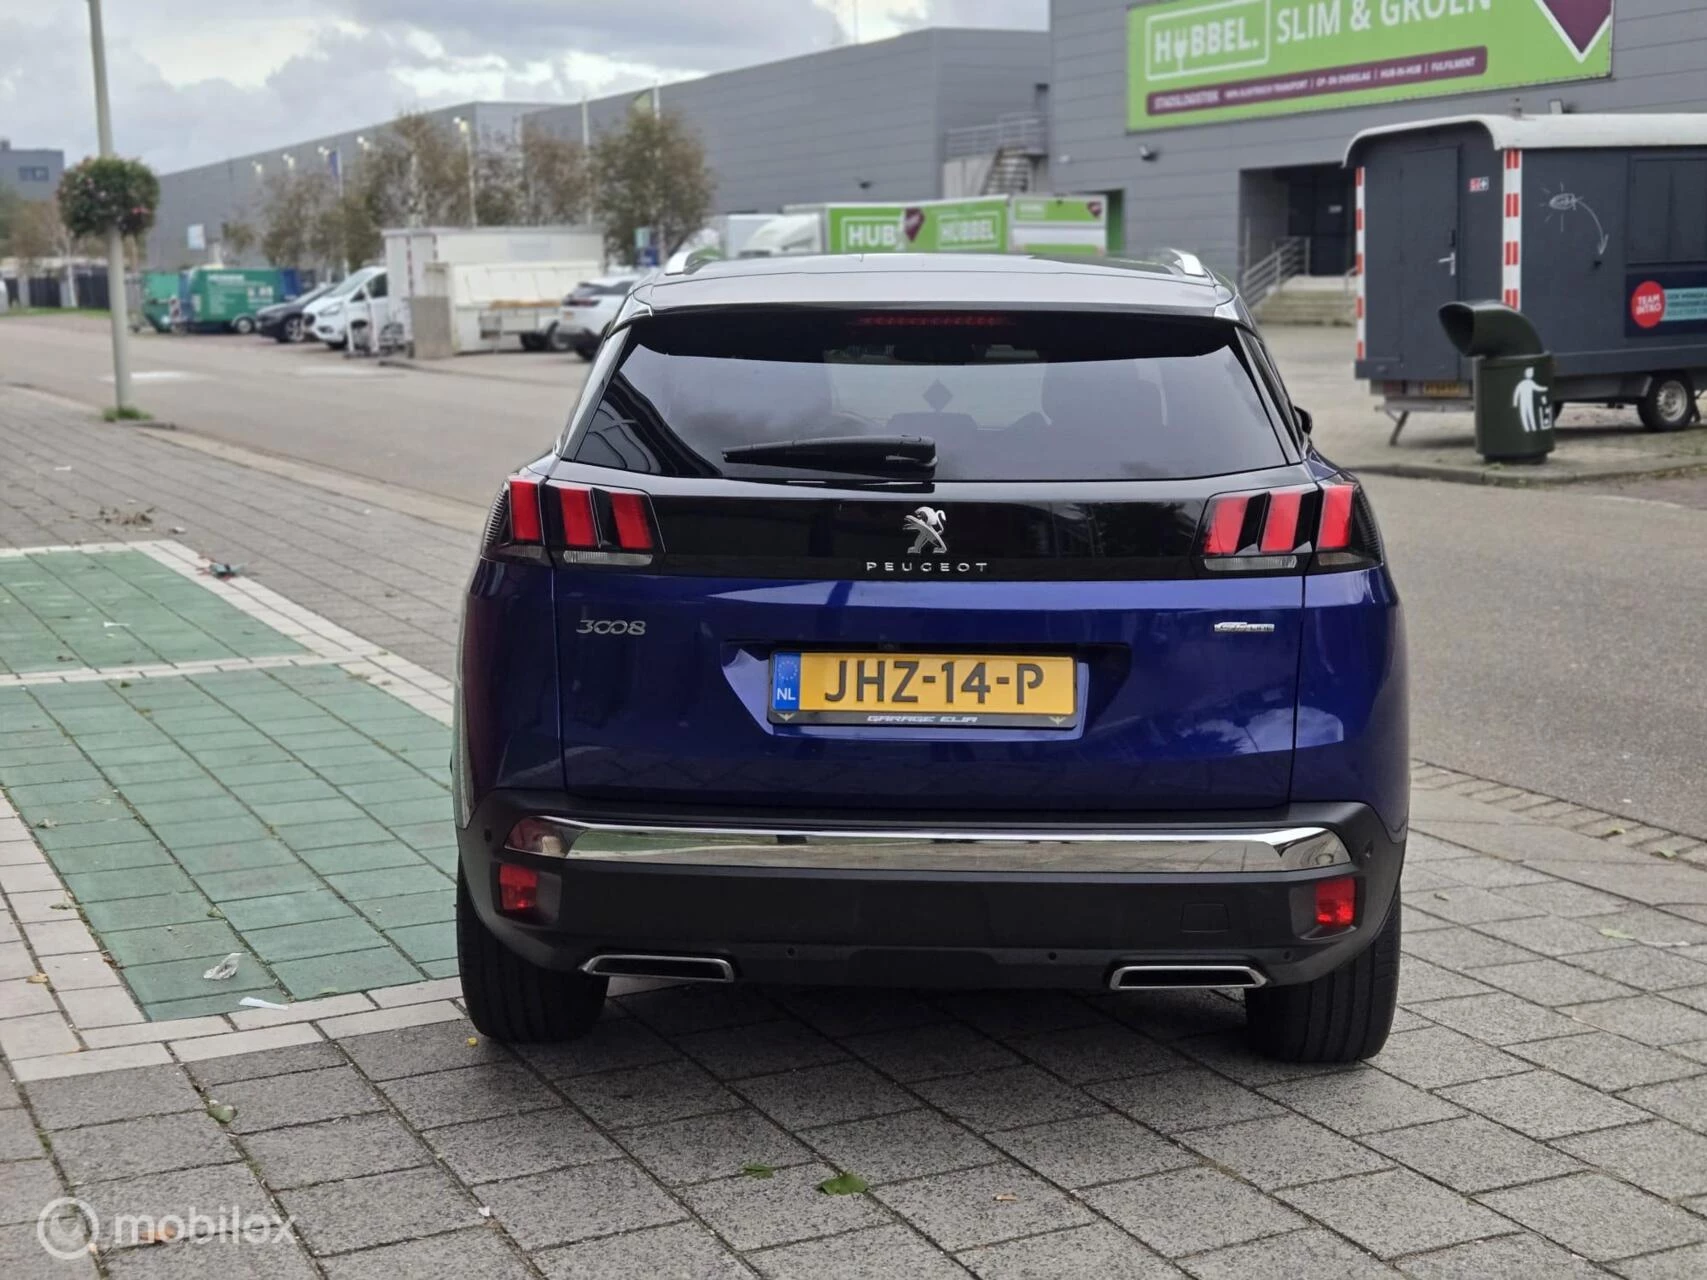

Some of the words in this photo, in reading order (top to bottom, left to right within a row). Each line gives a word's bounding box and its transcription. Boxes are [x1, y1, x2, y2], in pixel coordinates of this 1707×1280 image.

[1276, 2, 1341, 45] SLIM
[1350, 0, 1371, 31] &
[1637, 294, 1660, 305] TEAM
[865, 561, 989, 574] PEUGEOT
[576, 619, 647, 636] 3008
[824, 659, 1045, 706] JHZ-14-P
[776, 687, 797, 702] NL
[867, 714, 936, 723] GARAGE
